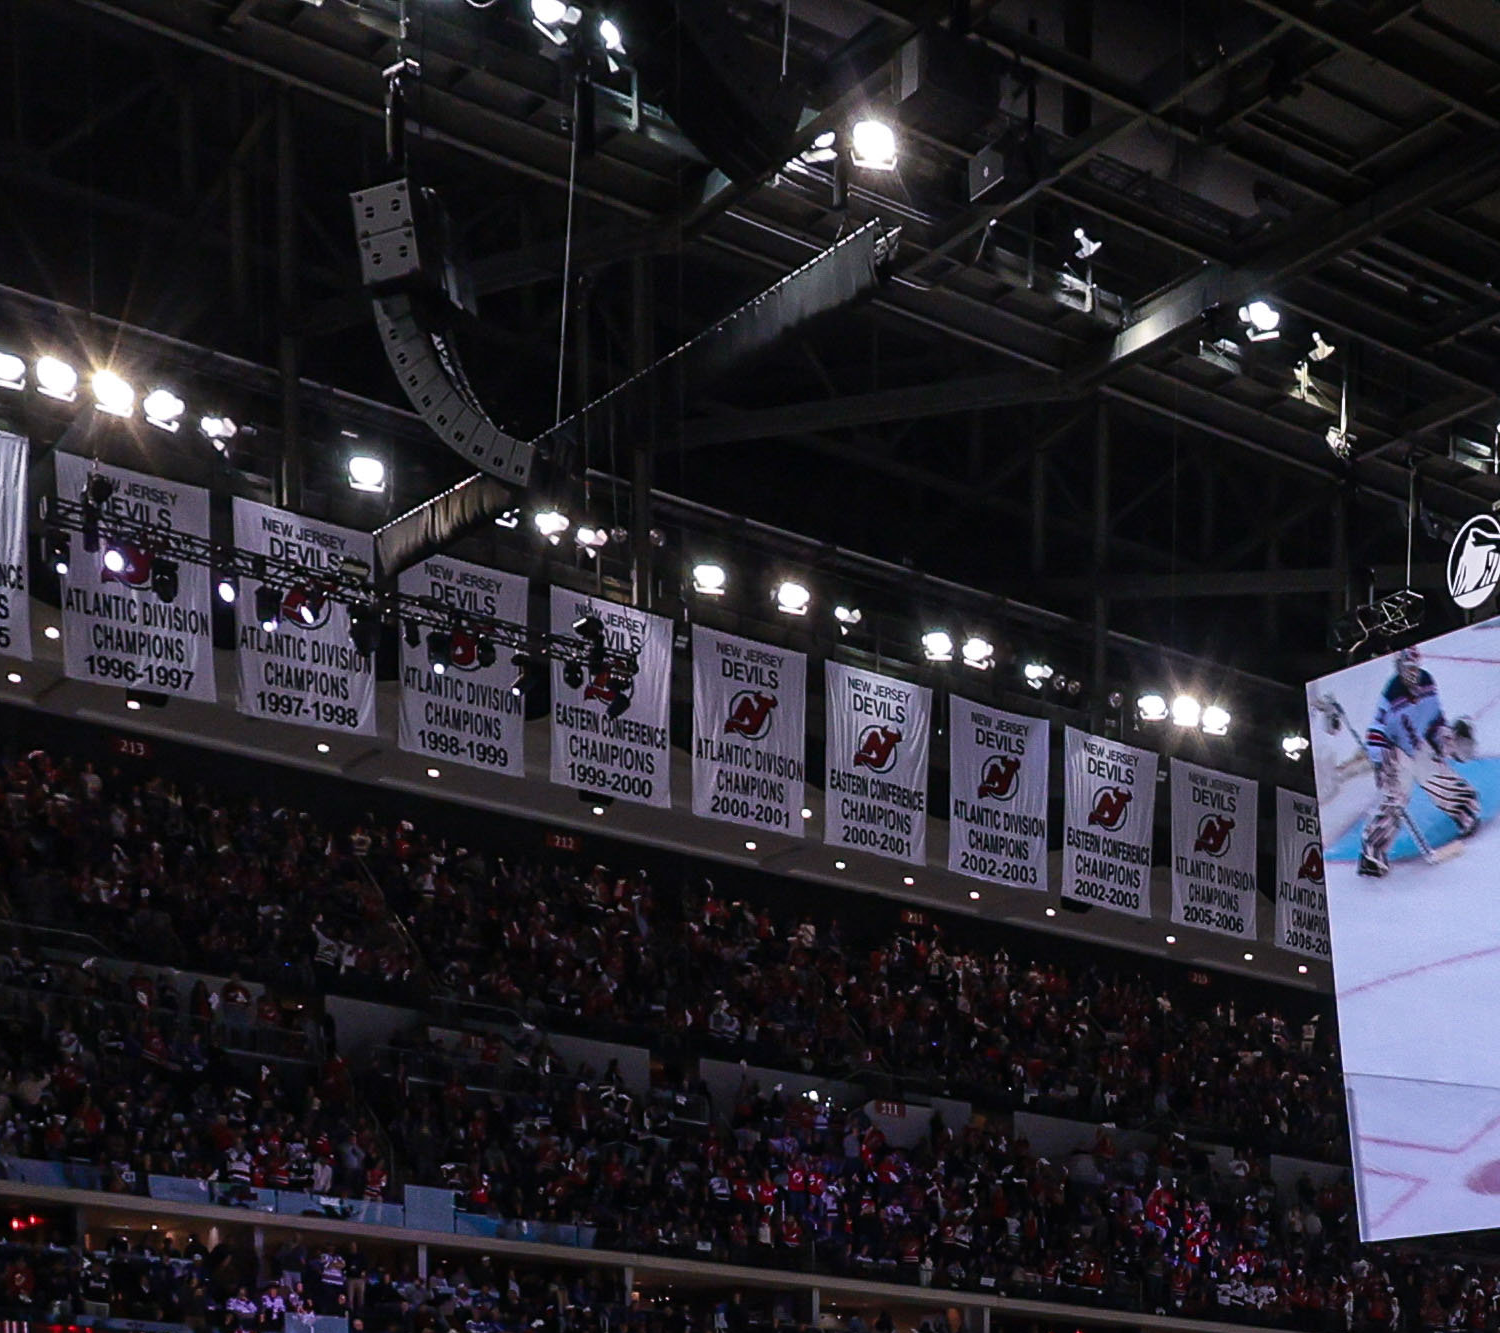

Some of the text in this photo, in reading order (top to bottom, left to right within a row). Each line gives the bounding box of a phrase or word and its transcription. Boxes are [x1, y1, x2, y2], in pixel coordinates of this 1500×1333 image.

[66, 588, 209, 636] ATLANTIC DIVISION
[430, 582, 496, 615] DEVILS
[92, 625, 185, 663] CHAMPIONS
[241, 625, 306, 662] ATLANTIC
[86, 655, 194, 691] 1996-1997
[264, 662, 349, 700] CHAMPIONS
[404, 665, 462, 699] ATLANTIC
[722, 660, 778, 690] DEVILS
[257, 691, 358, 728] 1997-1998
[424, 702, 501, 740] CHAMPIONS
[555, 703, 599, 734] EASTERN
[853, 695, 905, 724] DEVILS
[418, 730, 508, 767] 1998-1999
[569, 735, 655, 775] CHAMPIONS
[976, 728, 1025, 756] DEVILS
[696, 738, 803, 783] ATLANTIC DIVISION
[1088, 758, 1134, 785] DEVILS
[568, 761, 652, 798] 1999-2000
[717, 769, 784, 804] CHAMPIONS
[830, 769, 924, 812] EASTERN CONFERENCE
[711, 795, 790, 828] 2000-2001
[841, 799, 912, 835] CHAMPIONS
[1192, 787, 1236, 813] DEVILS
[954, 800, 1045, 839] ATLANTIC DIVISION
[843, 826, 912, 857] 2000-2001
[969, 829, 1029, 860] CHAMPIONS
[1067, 827, 1150, 866] EASTERN CONFERENCE
[961, 852, 1037, 884] 2002-2003
[1076, 854, 1141, 889] CHAMPIONS
[1176, 856, 1255, 891] ATLANTIC DIVISION
[1075, 879, 1139, 909] 2002-2003
[1189, 884, 1239, 912] CHAMPIONS
[1279, 882, 1316, 909] ATLANTIC
[1183, 906, 1244, 932] 2005-2006
